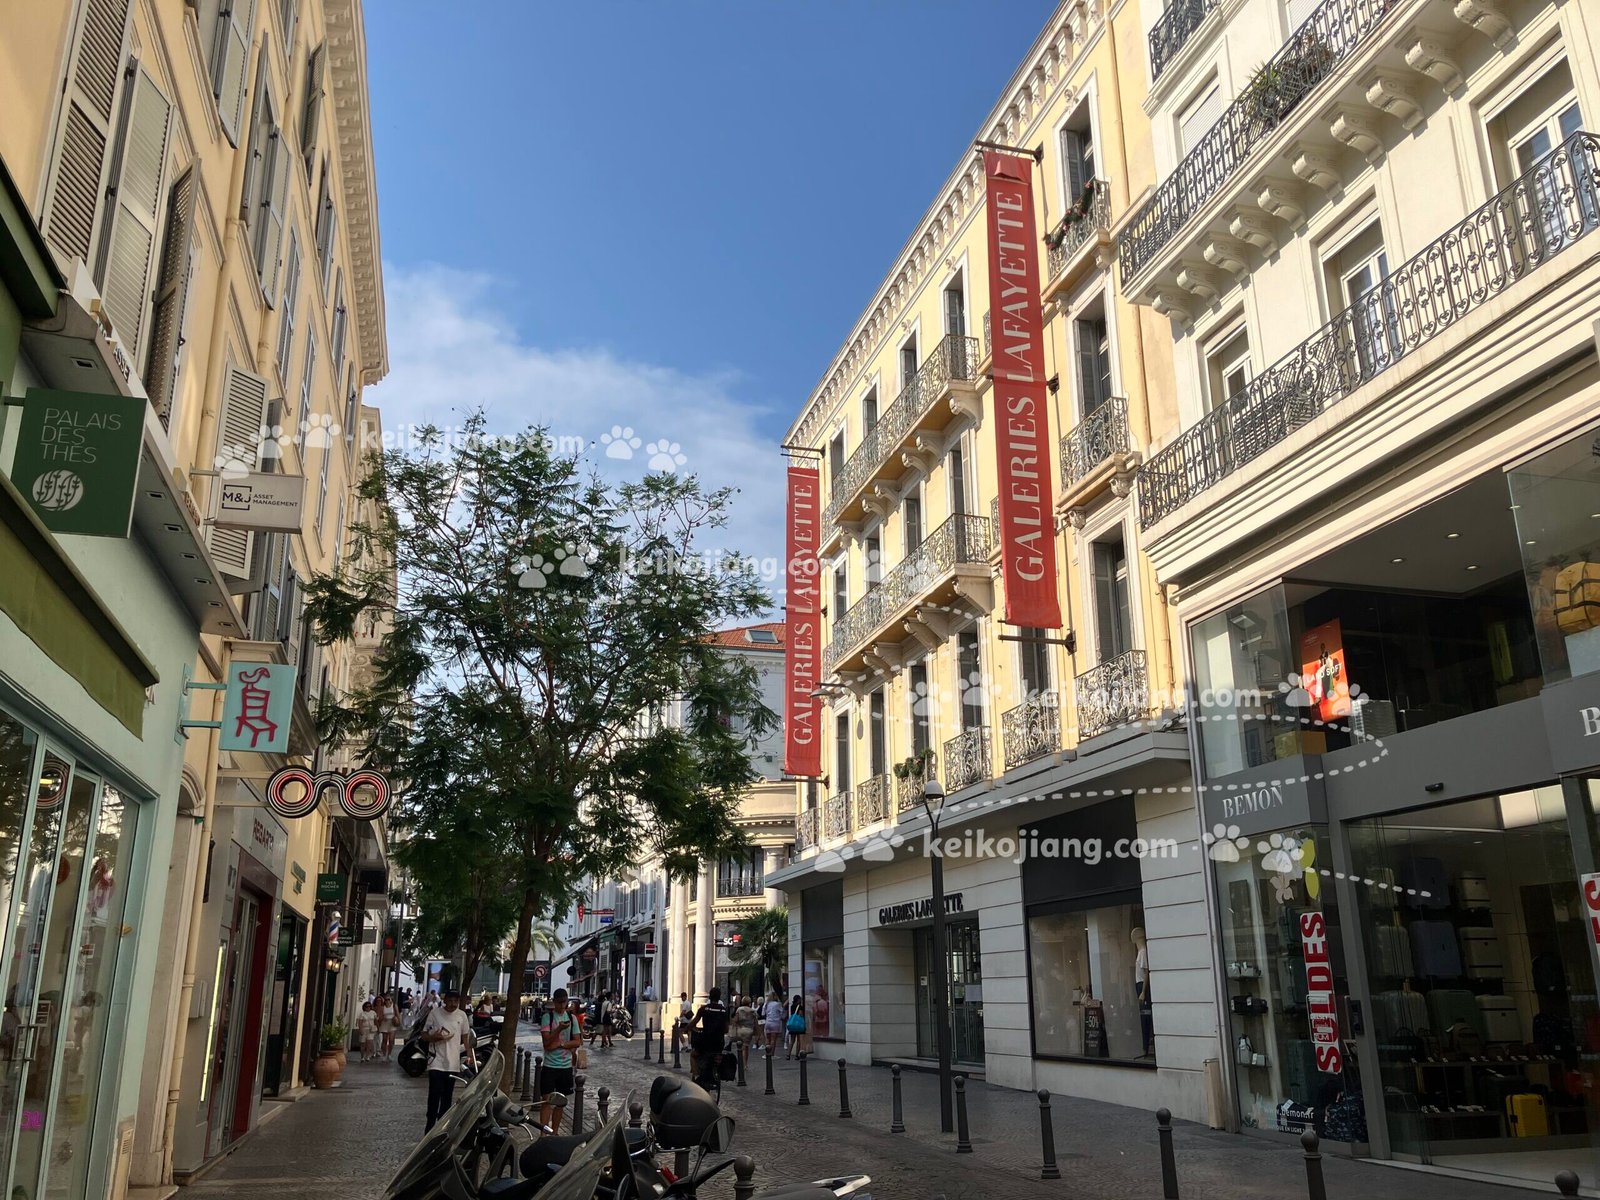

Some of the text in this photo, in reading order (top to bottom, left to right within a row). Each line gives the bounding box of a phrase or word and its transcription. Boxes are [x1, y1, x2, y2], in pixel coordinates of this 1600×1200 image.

[996, 192, 1045, 582] GALERIES LAFAYETTE
[43, 408, 122, 431] PALAIS
[41, 425, 85, 444] DES
[40, 441, 97, 464] THÉS
[222, 492, 252, 503] M&J
[793, 485, 813, 745] GALERIES LAFAYETTE
[1222, 785, 1284, 818] BEMON
[879, 902, 914, 925] GALERIES
[723, 937, 733, 946] SG
[1301, 912, 1343, 1073] SOLDES
